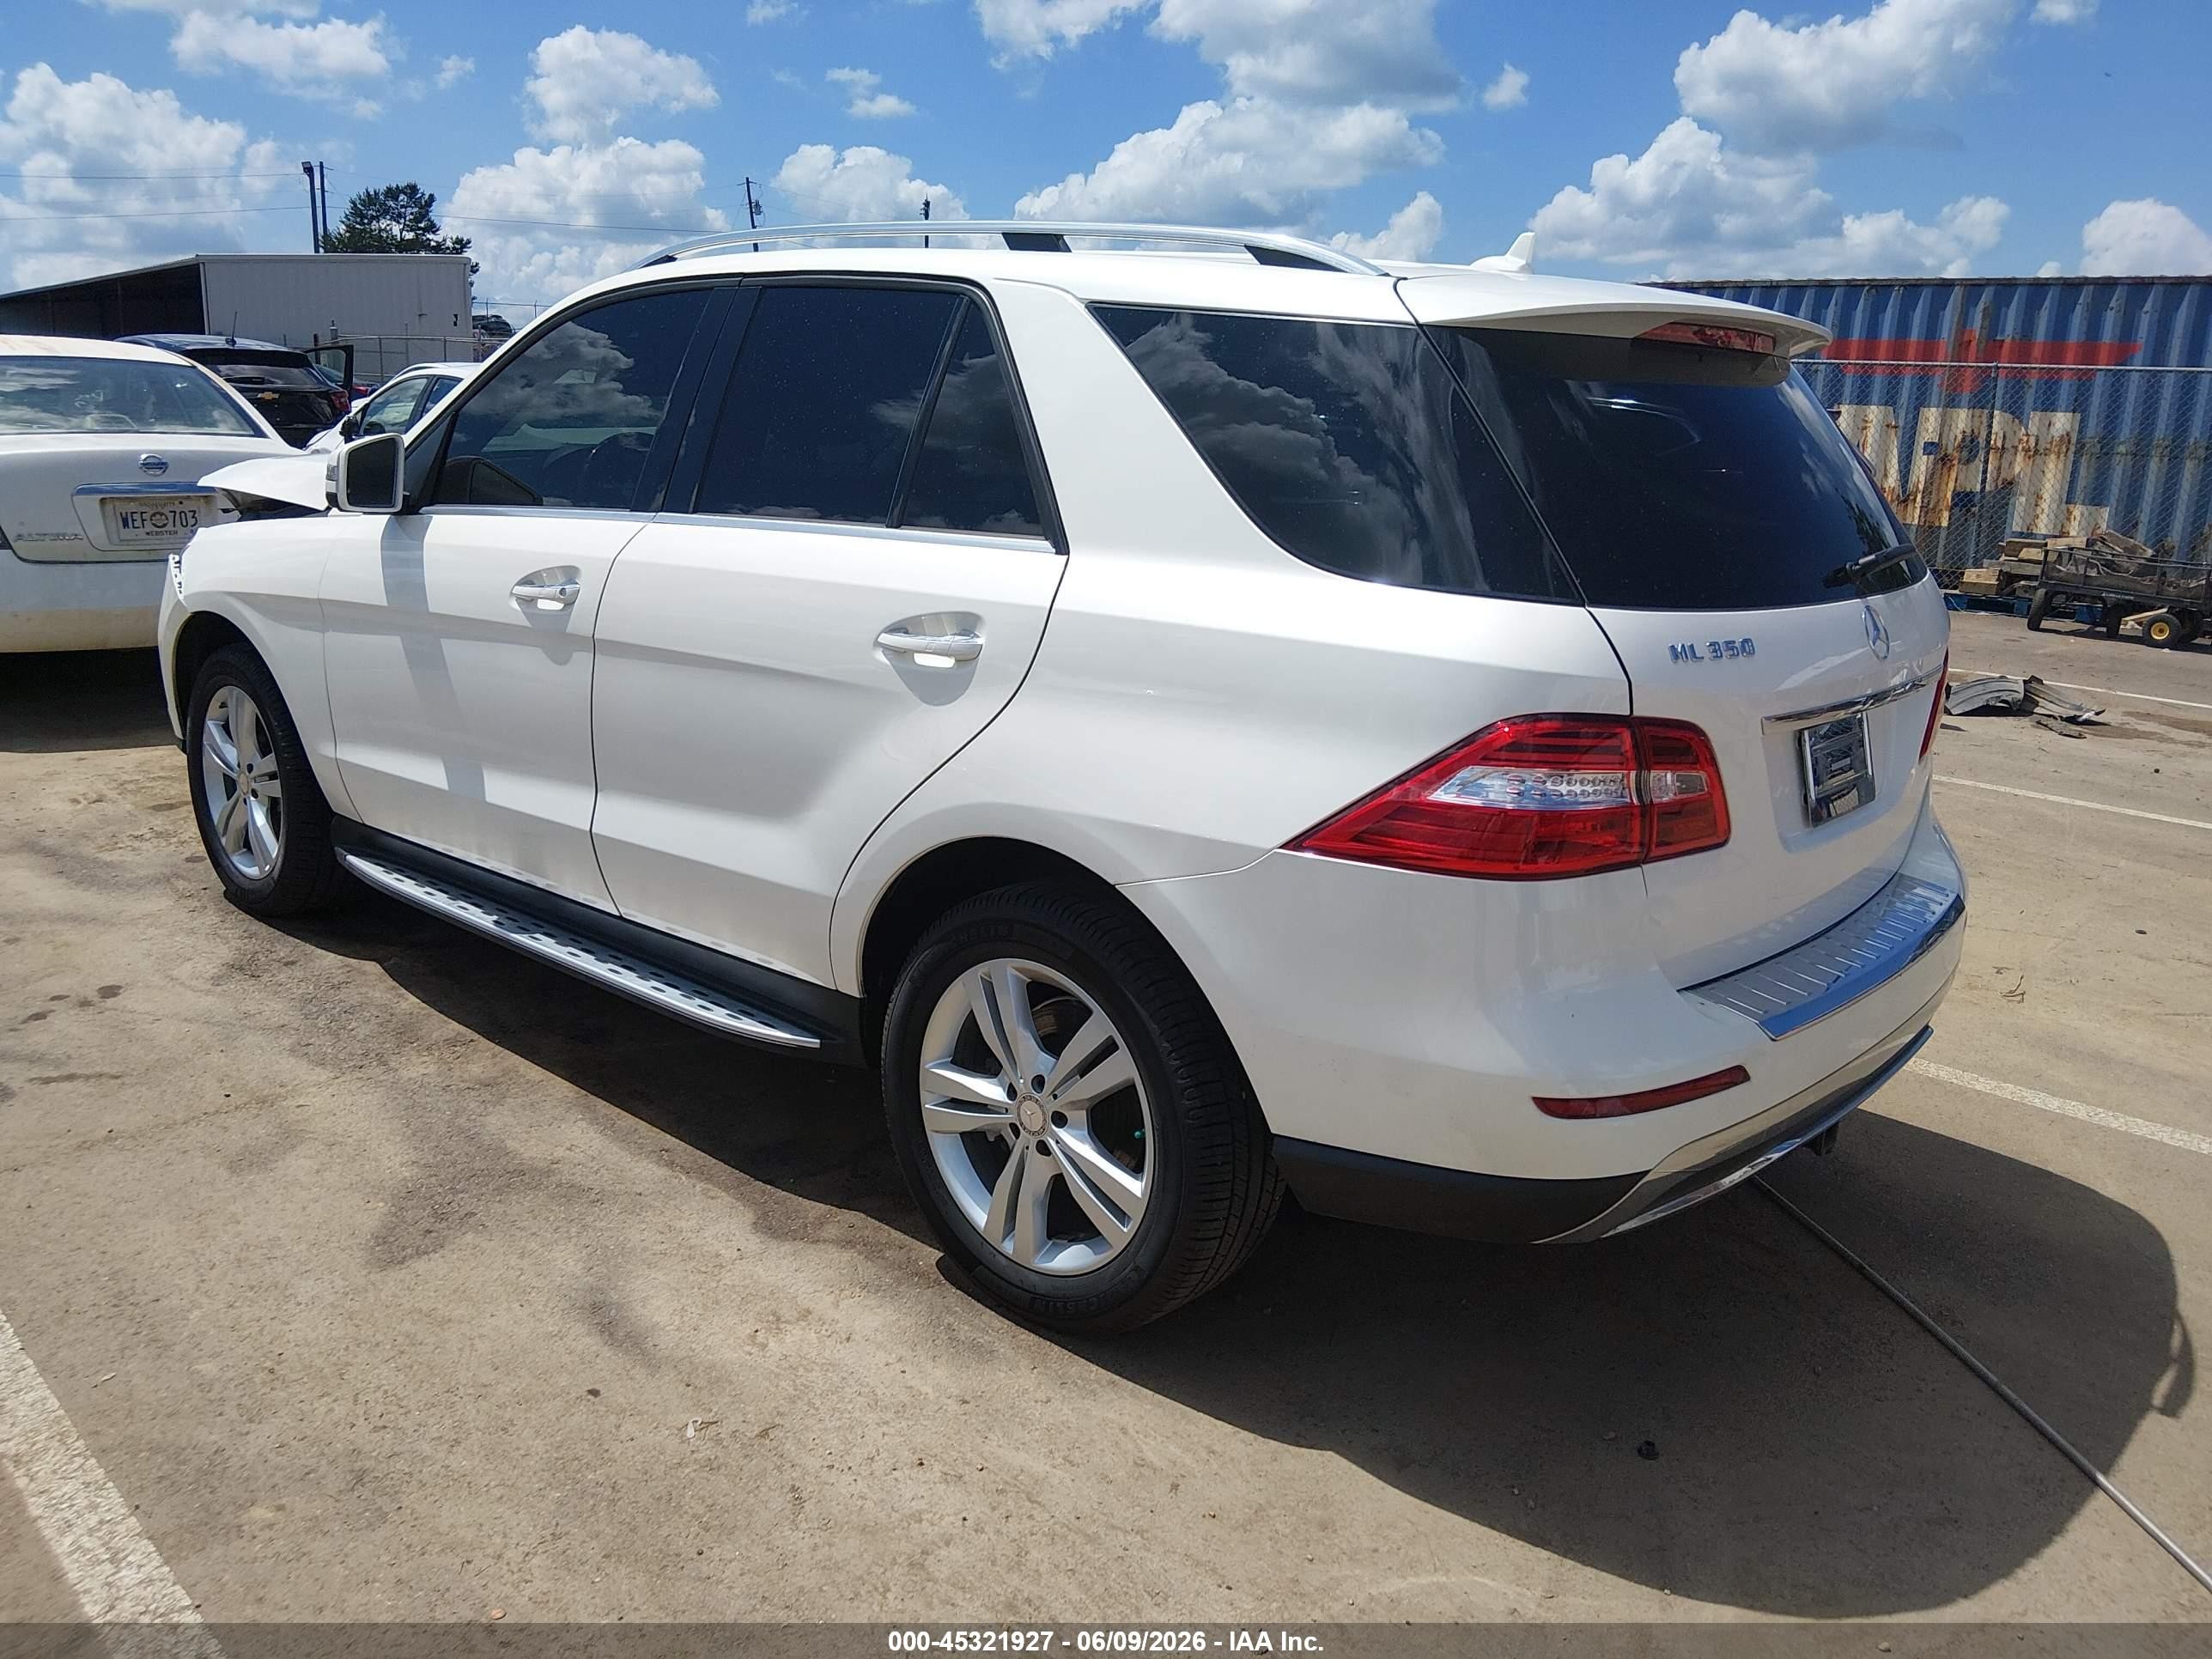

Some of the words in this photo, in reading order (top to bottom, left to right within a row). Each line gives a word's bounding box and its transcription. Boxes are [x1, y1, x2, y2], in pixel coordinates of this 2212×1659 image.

[119, 511, 149, 529] WEF
[168, 509, 198, 528] 703
[1668, 642, 1705, 664] ML
[1705, 637, 1756, 661] 350
